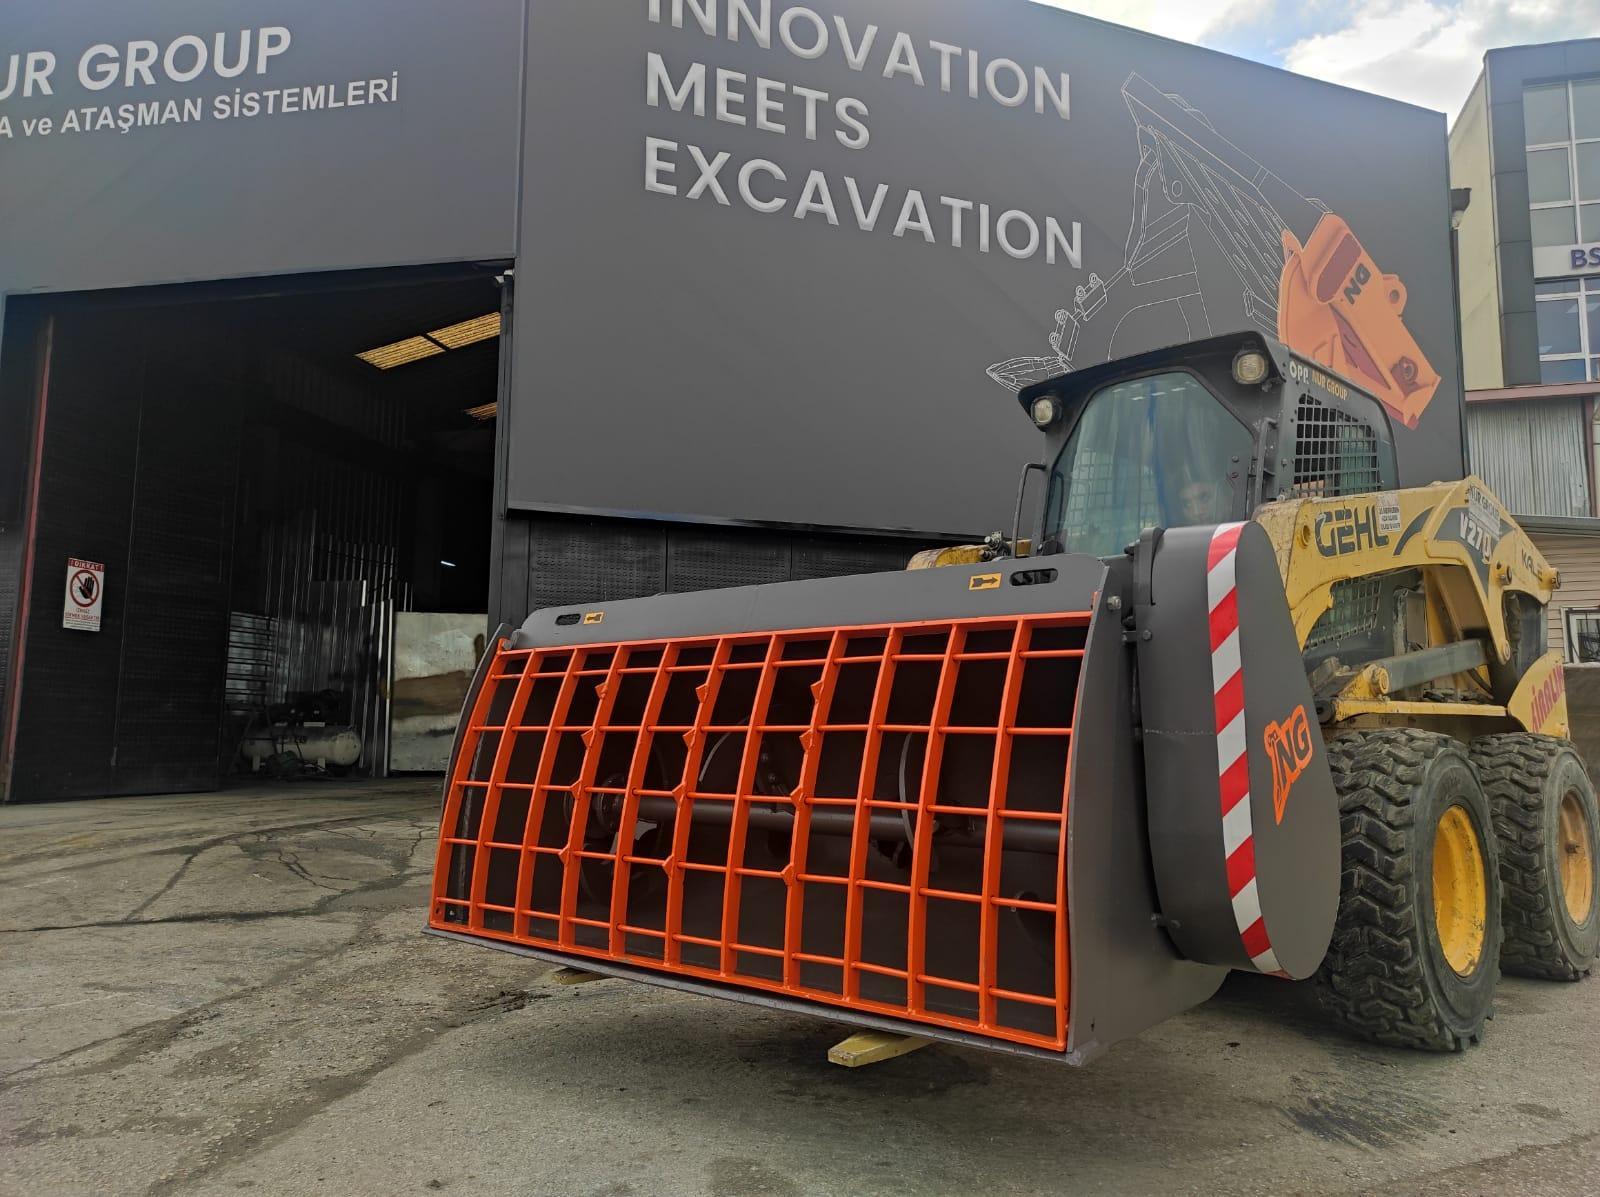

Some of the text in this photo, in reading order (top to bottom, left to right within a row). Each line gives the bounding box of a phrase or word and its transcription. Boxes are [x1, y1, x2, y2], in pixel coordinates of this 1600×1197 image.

[78, 26, 292, 91] GROUP
[22, 118, 53, 137] ve
[61, 97, 202, 134] ATAŞMAN
[212, 71, 399, 120] SİSTEMLERİ
[646, 51, 870, 150] MEETS
[645, 136, 1082, 269] EXCAVATION
[1326, 379, 1348, 401] GROUP
[1314, 505, 1390, 557] GEHL
[1460, 511, 1493, 565] V270
